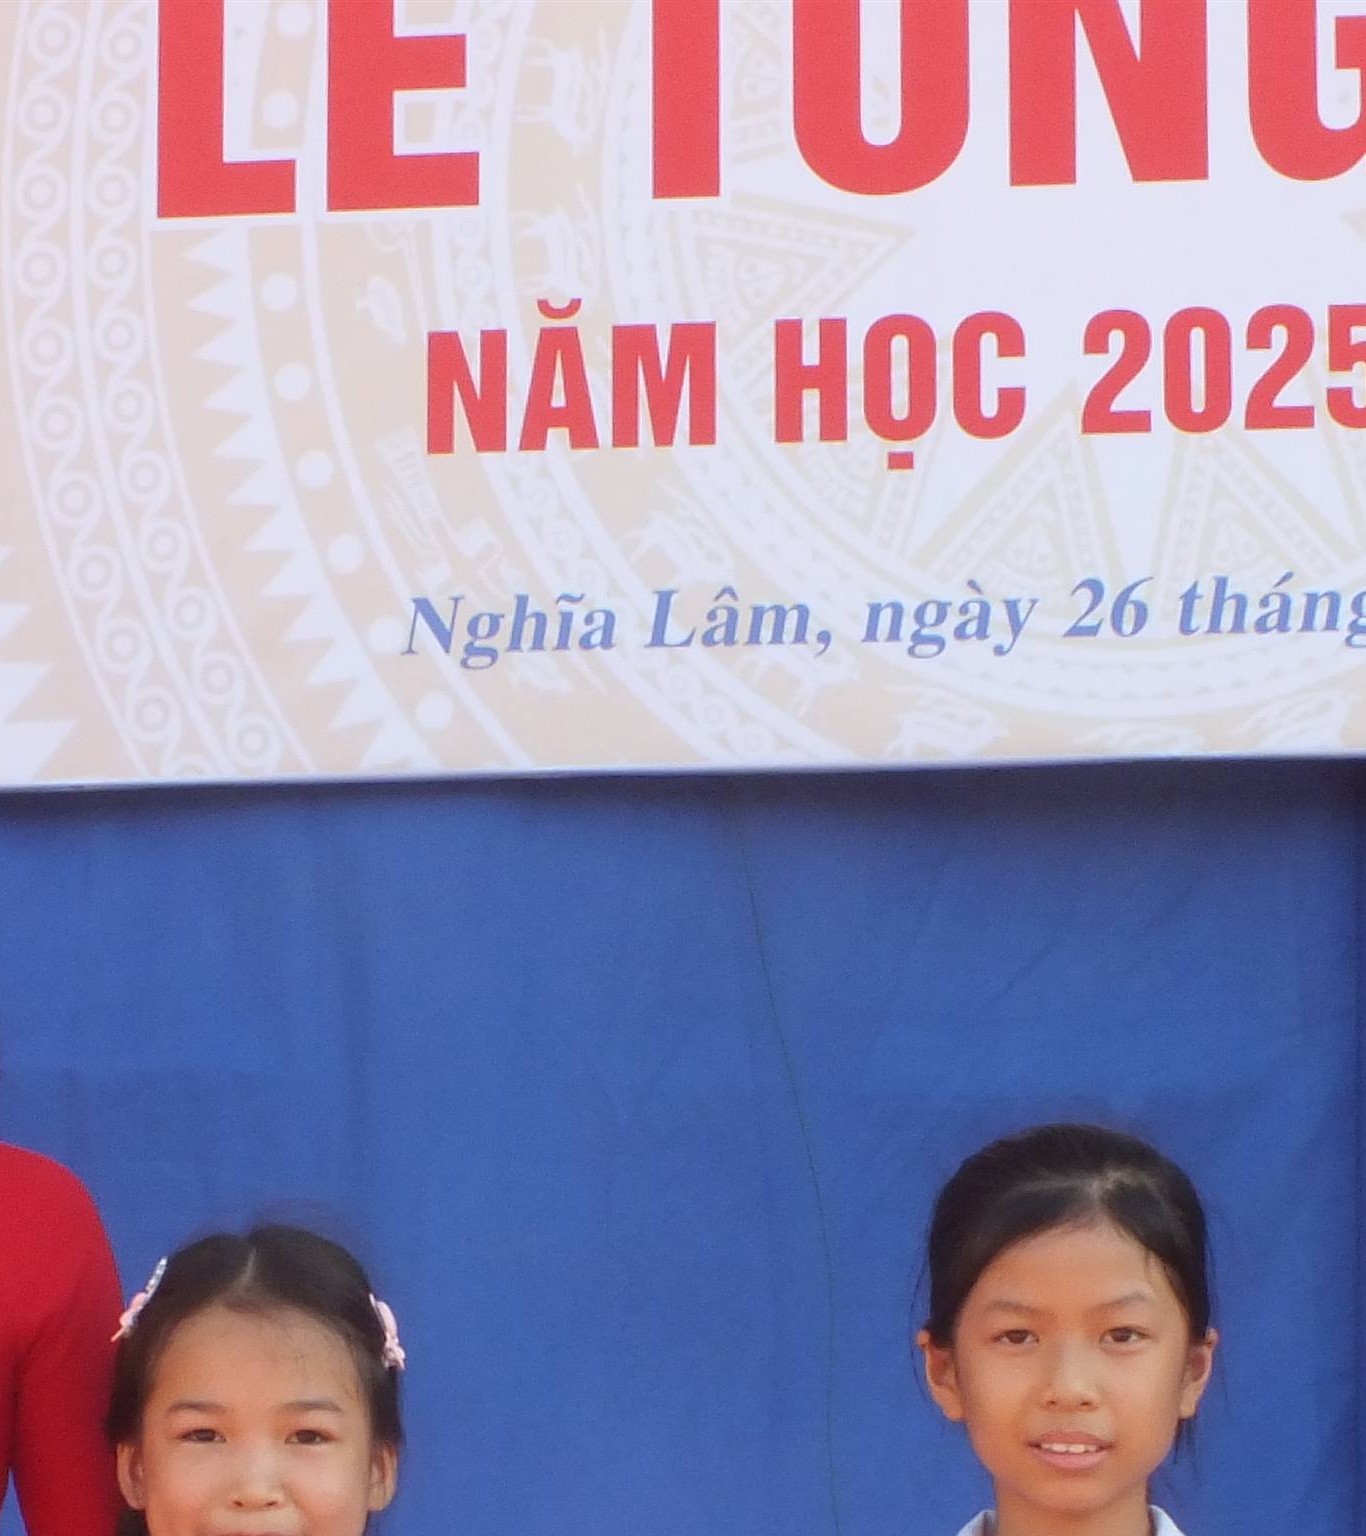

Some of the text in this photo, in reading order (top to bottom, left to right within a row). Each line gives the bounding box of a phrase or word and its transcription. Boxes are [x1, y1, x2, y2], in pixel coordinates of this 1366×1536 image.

[426, 298, 717, 455] NĂM
[774, 312, 1026, 470] HỌC
[401, 592, 618, 670] Nghĩa
[644, 585, 834, 656] Lâm,
[859, 580, 1039, 659] ngày
[1062, 576, 1155, 639] 26
